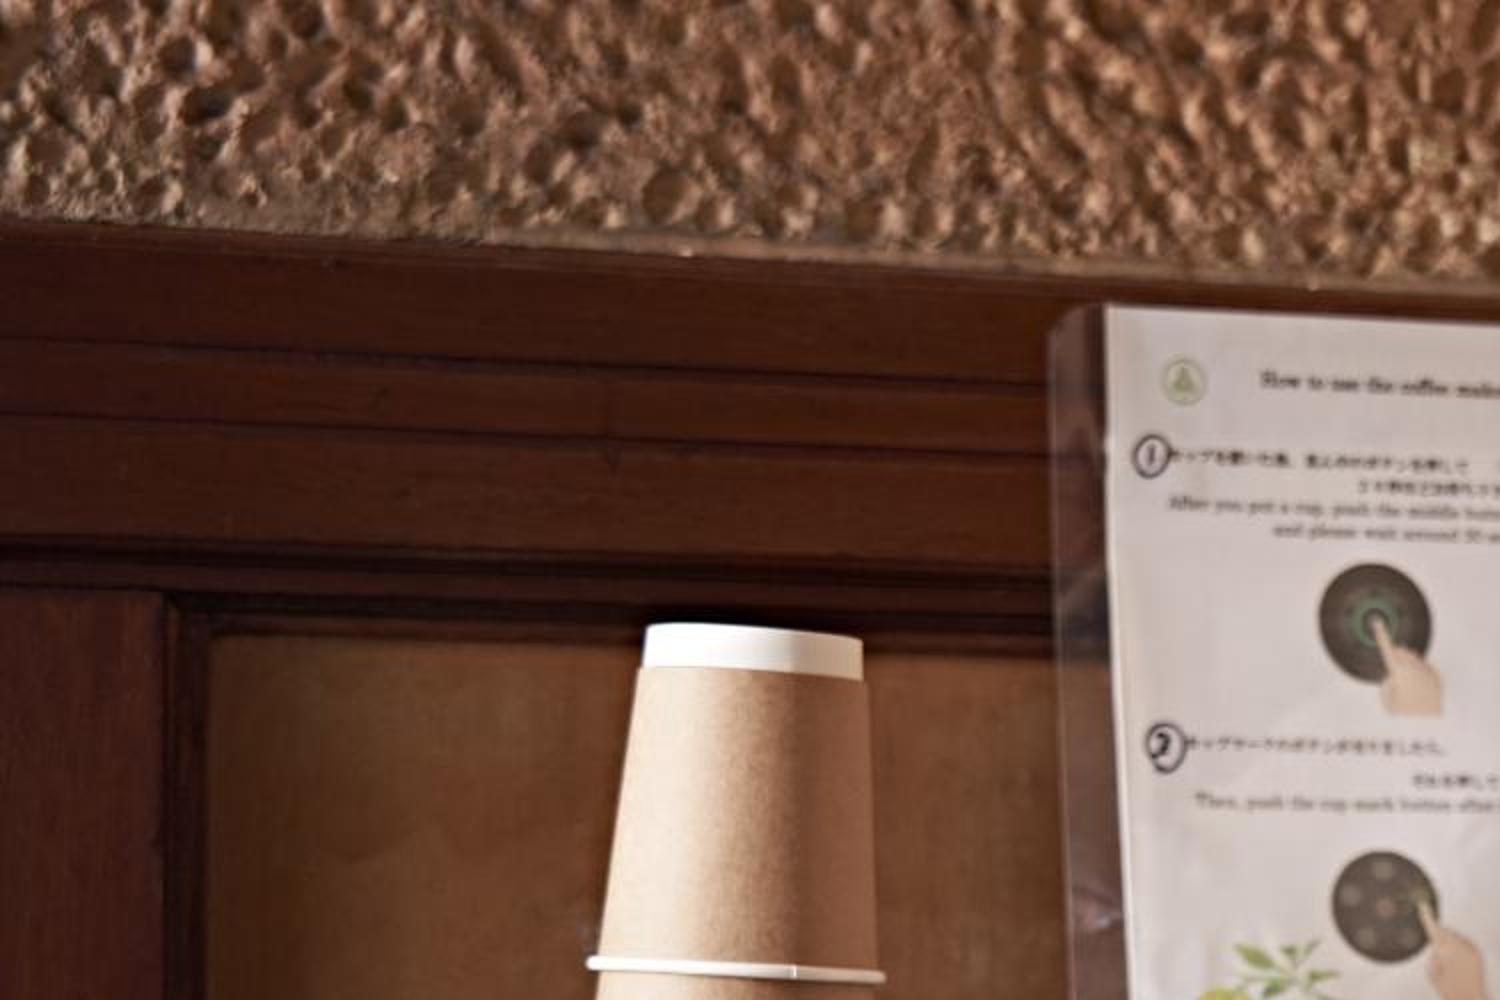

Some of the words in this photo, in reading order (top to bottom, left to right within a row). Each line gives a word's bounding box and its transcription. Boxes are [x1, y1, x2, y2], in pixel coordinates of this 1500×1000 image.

[1261, 369, 1300, 389] How
[1308, 375, 1323, 390] to
[1332, 378, 1359, 392] use
[1368, 376, 1393, 393] the
[1401, 376, 1449, 395] coffee
[1169, 494, 1210, 511] After
[1216, 500, 1242, 514] you
[1248, 500, 1274, 516] put
[1333, 502, 1369, 519] push
[1378, 503, 1402, 517] the
[1408, 504, 1459, 519] middle
[1274, 523, 1303, 538] and
[1309, 523, 1356, 540] please
[1364, 526, 1397, 540] wait
[1404, 527, 1457, 541] around
[1247, 796, 1282, 812] push
[1293, 796, 1314, 811] the
[1320, 799, 1345, 814] cup
[1355, 798, 1393, 812] mark
[1400, 799, 1450, 813] button
[1458, 799, 1494, 813] after
